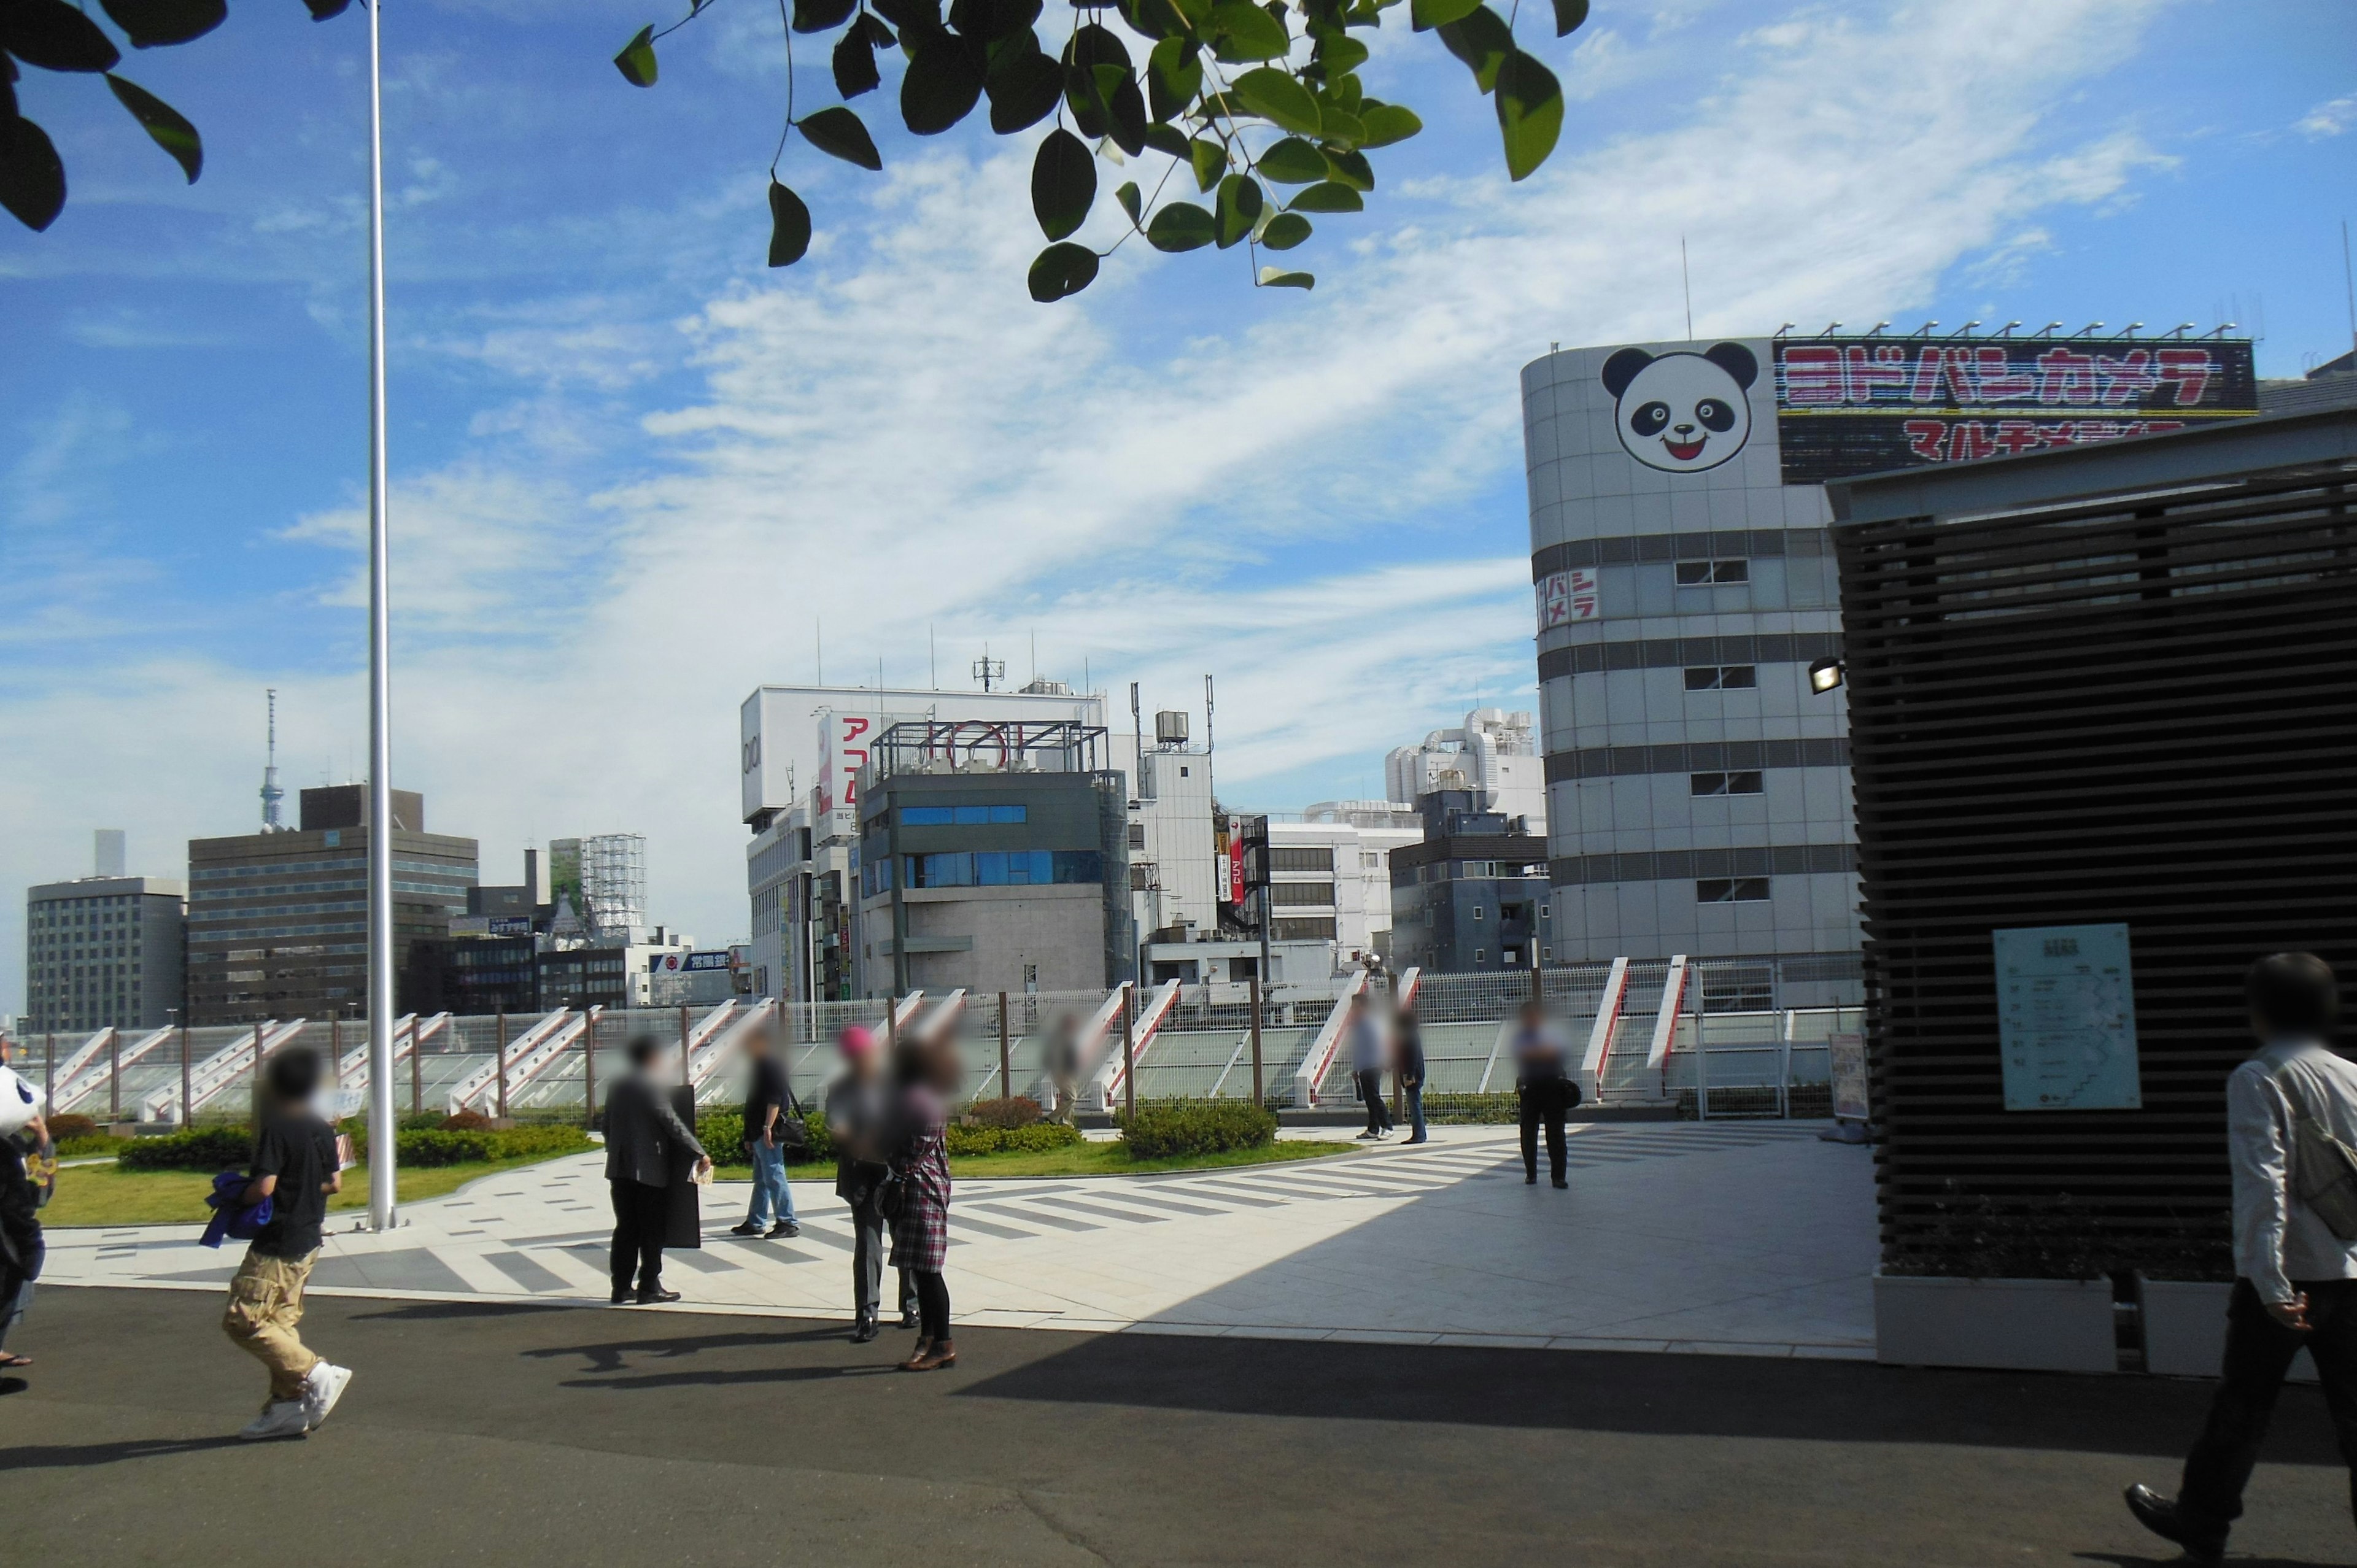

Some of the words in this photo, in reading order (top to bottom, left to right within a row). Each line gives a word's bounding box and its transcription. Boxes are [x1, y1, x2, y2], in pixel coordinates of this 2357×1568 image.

[1782, 345, 2212, 406] ヨドバシカメラ
[1538, 572, 1594, 599] バシ
[1539, 597, 1594, 624] メラ
